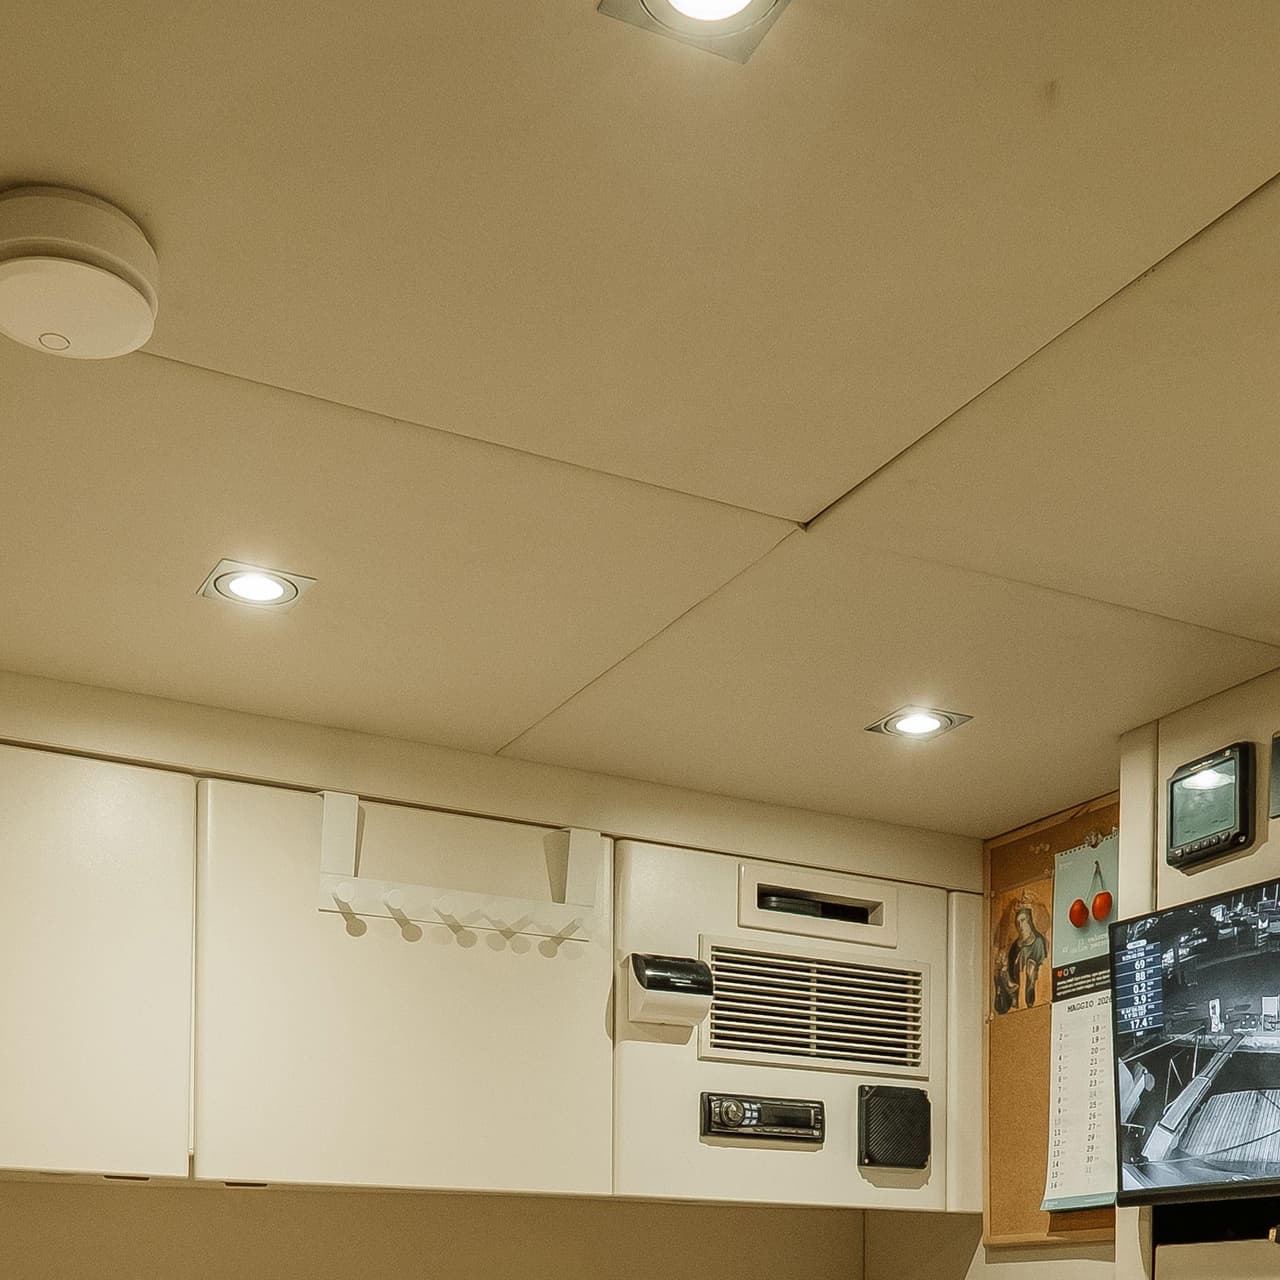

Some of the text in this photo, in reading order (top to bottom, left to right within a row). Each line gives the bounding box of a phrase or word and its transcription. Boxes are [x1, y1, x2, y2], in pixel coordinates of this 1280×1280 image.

[1134, 959, 1145, 969] 69
[1133, 983, 1146, 993] 0.2
[1133, 994, 1146, 1005] 3.9
[1067, 1000, 1094, 1013] MAGGIO
[1130, 1017, 1147, 1030] 17.4
